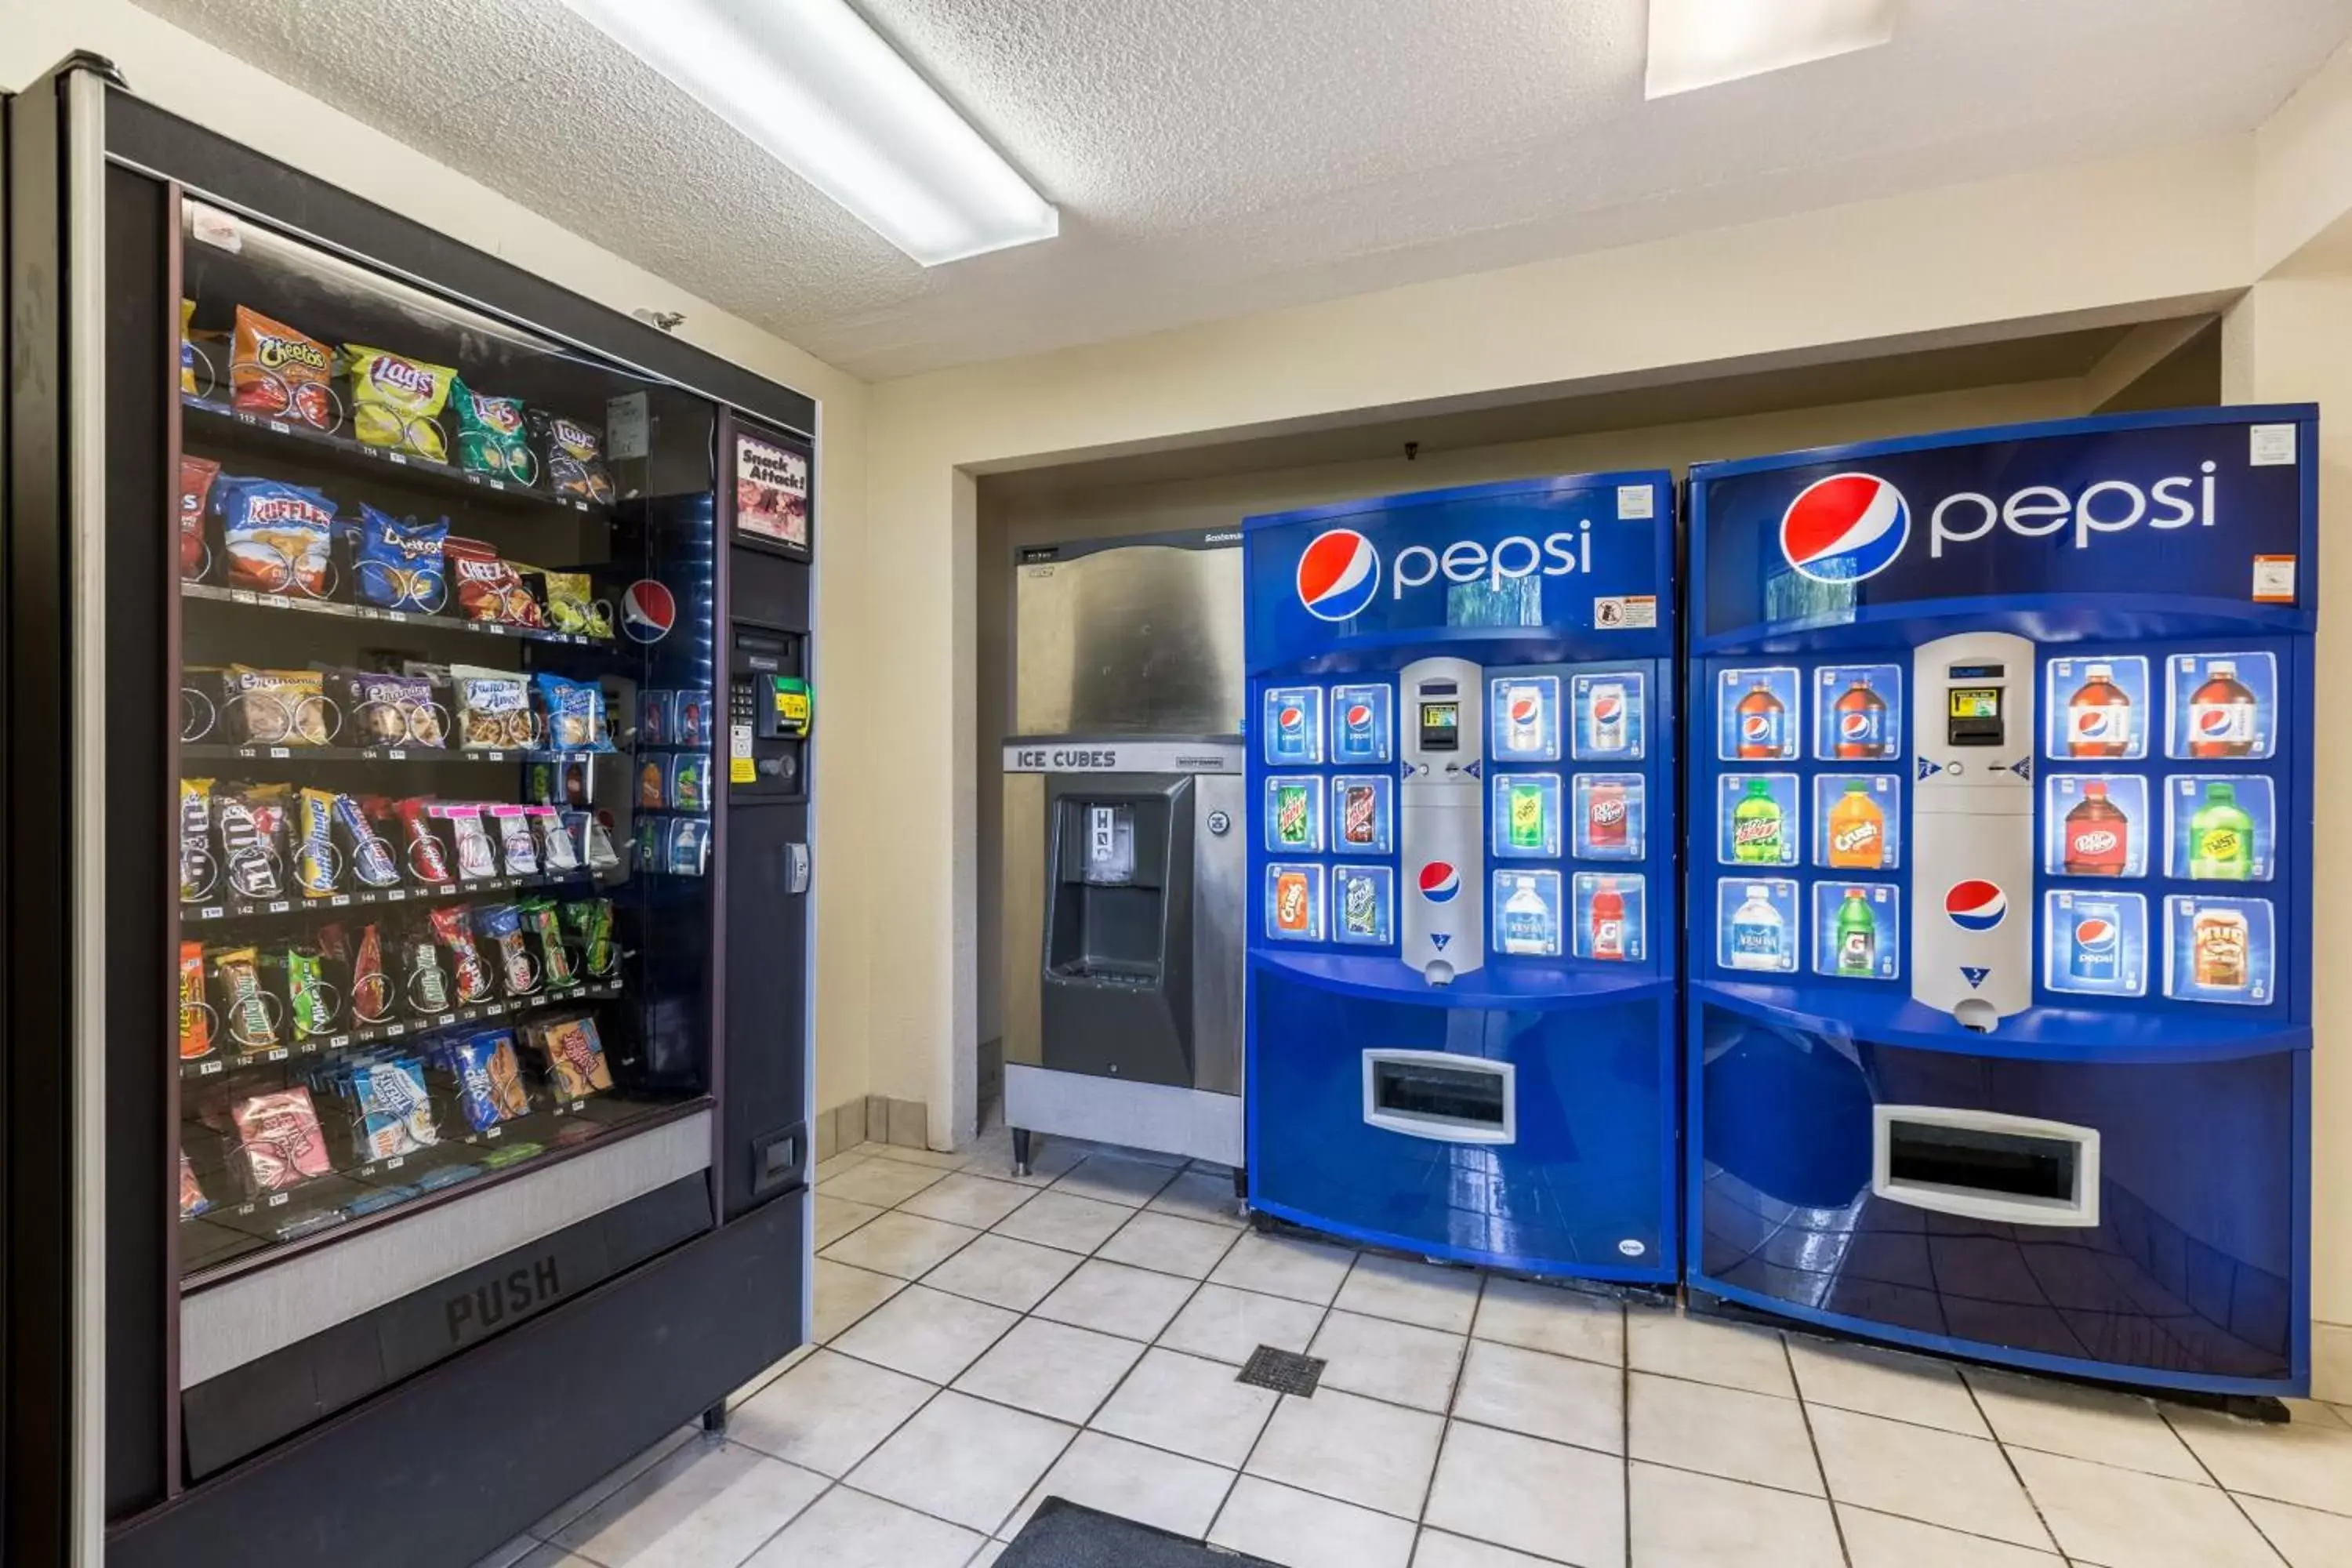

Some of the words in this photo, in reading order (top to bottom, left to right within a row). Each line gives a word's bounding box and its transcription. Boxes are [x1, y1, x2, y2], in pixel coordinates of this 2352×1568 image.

[260, 337, 326, 369] Cheetos
[743, 449, 789, 473] Snack
[750, 466, 805, 490] Attack!
[249, 495, 332, 527] RUFFLES
[1931, 460, 2217, 558] pepsi
[1393, 519, 1592, 601] pepsi
[1018, 750, 1046, 768] ICE
[1053, 750, 1116, 768] CUBES
[1601, 922, 1617, 939] G
[1846, 932, 1865, 953] G
[2079, 953, 2114, 964] pepsi
[445, 1254, 561, 1345] PUSH
